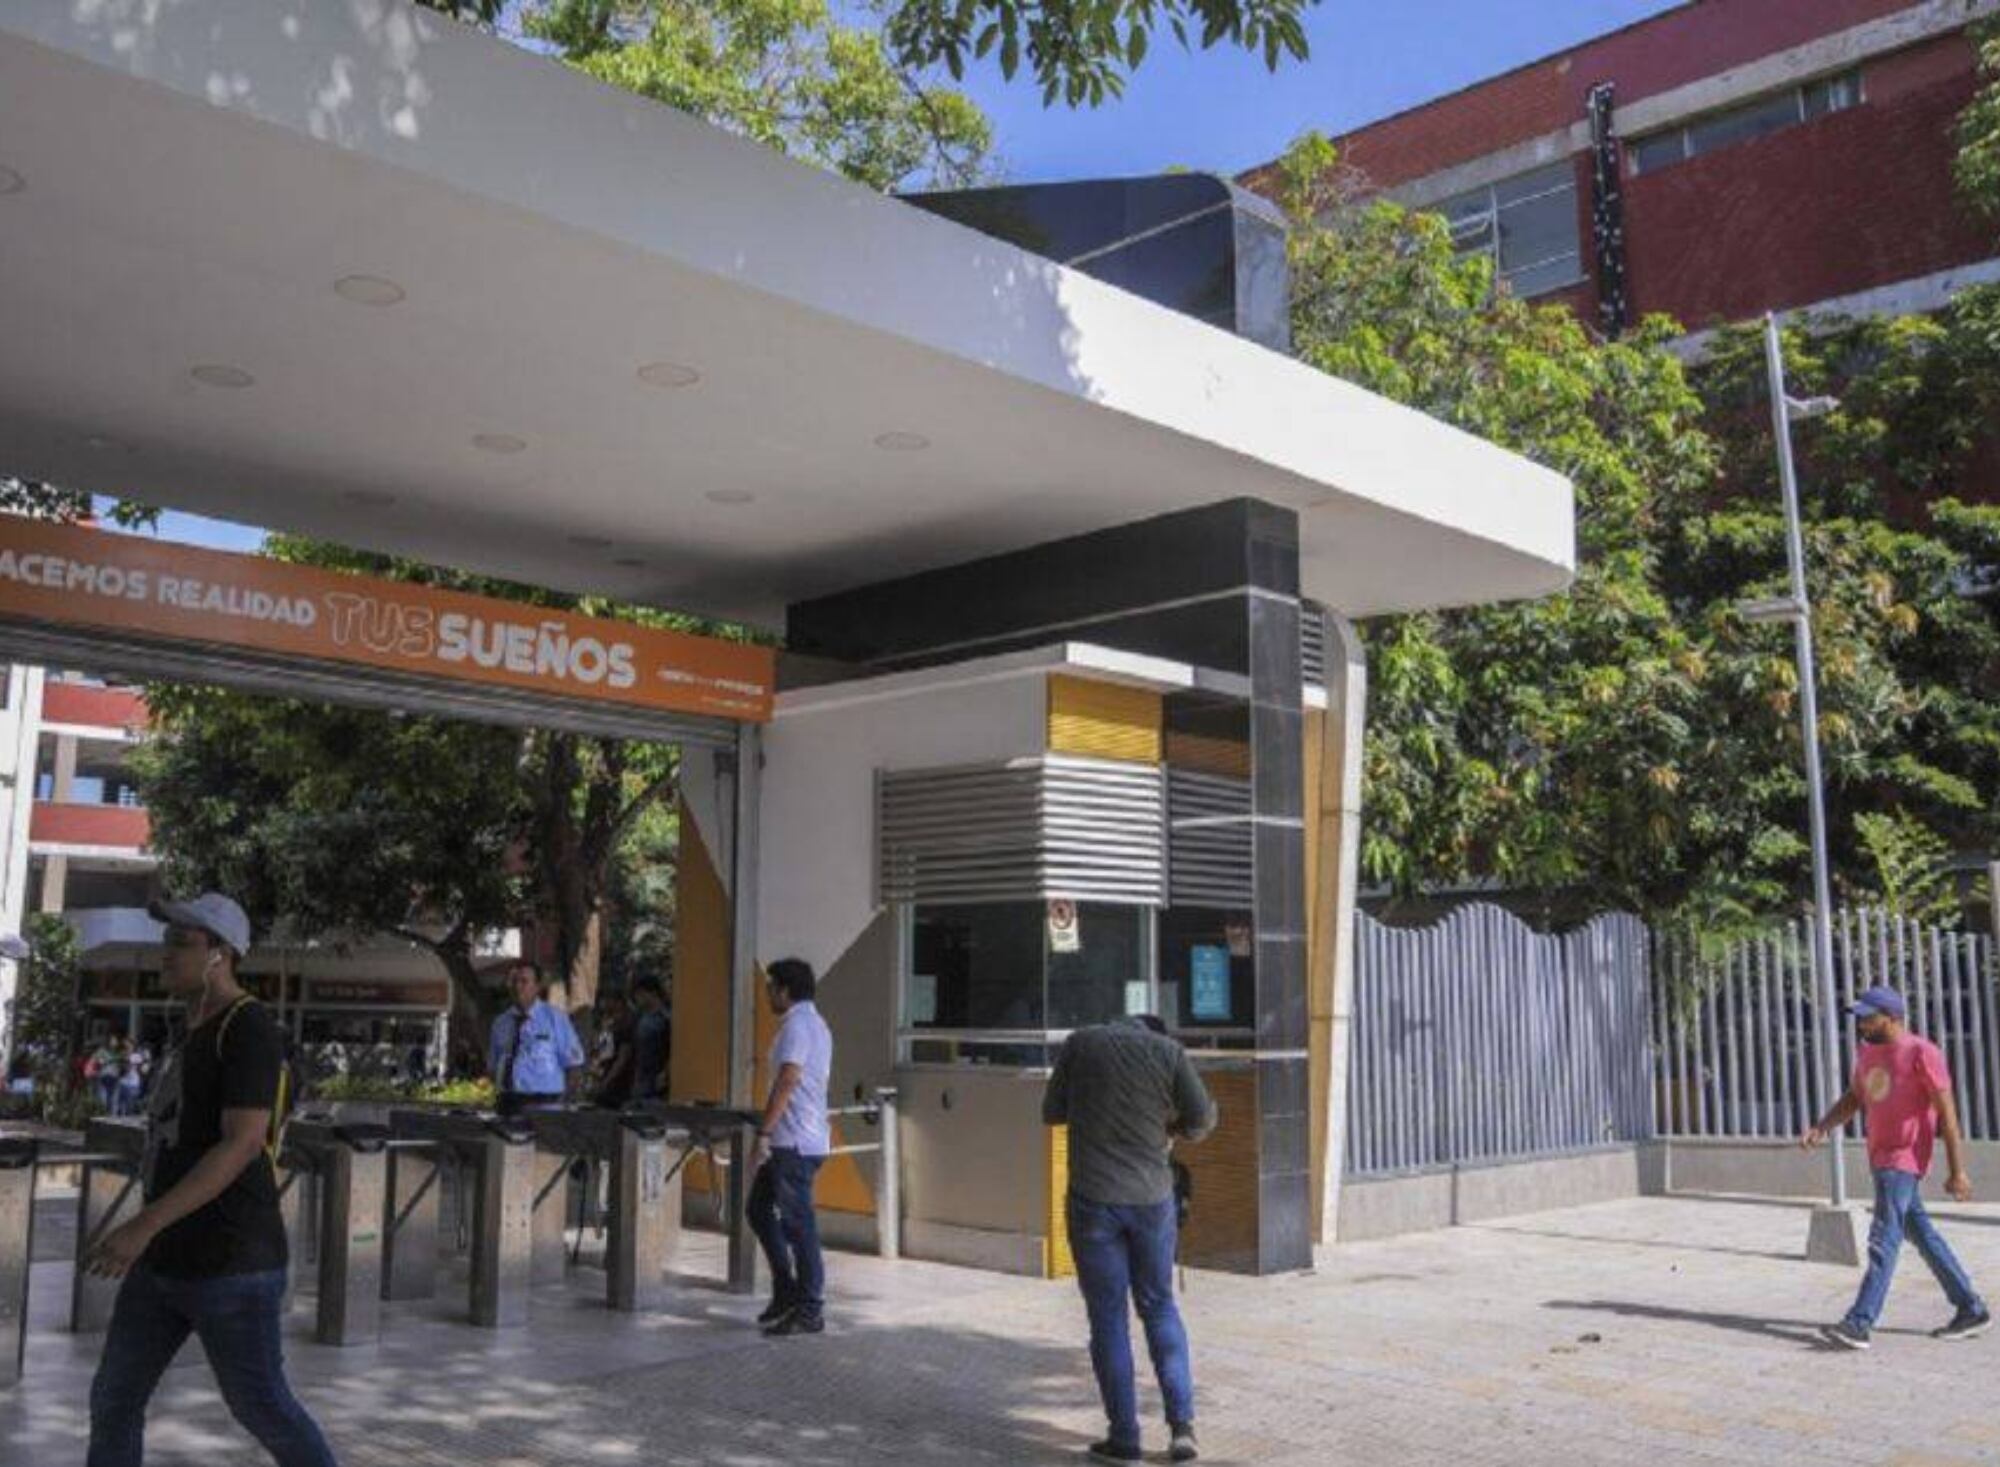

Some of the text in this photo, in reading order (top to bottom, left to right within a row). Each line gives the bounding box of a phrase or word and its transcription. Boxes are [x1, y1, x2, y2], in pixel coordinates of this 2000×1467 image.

[158, 576, 316, 627] REALIDAD
[326, 592, 434, 658] TUS
[437, 613, 636, 688] SUEÑOS
